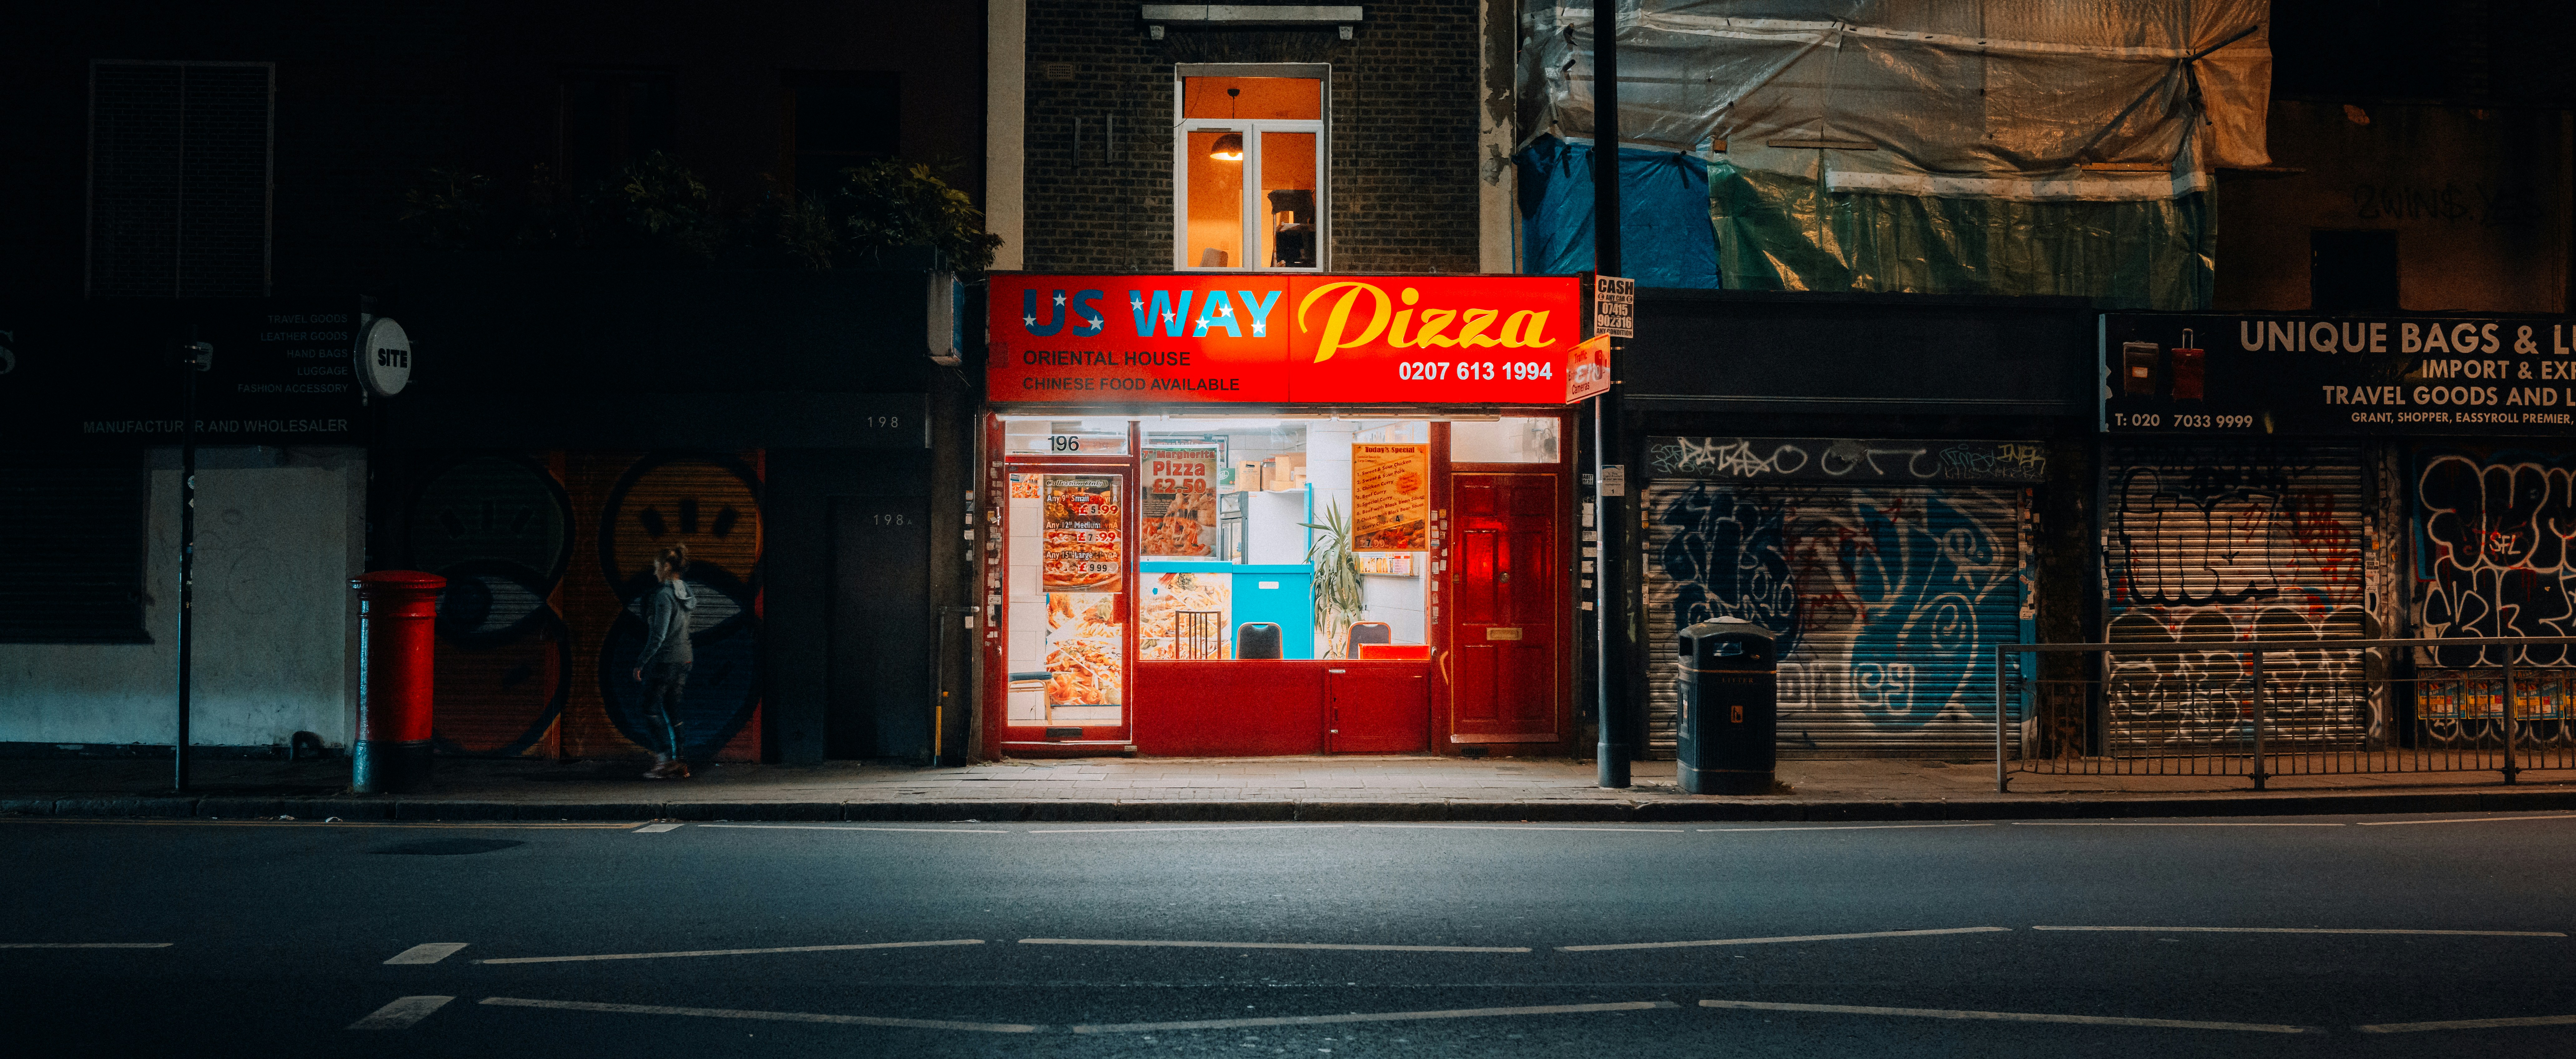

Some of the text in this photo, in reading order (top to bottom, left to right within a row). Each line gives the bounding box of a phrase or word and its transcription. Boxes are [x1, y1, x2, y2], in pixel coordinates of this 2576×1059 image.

[1598, 279, 1634, 295] CASH
[1023, 289, 1282, 337] US WAY
[1602, 302, 1628, 316] 07415
[268, 314, 348, 324] TRAVEL GOODS
[1298, 282, 1556, 363] Pizza
[1598, 314, 1632, 328] 902316
[261, 332, 348, 341] LEATHER GOODS
[2241, 321, 2576, 355] UNIQUE BAGS & L
[287, 349, 348, 358] HAND BAGS
[378, 348, 407, 368] SITE
[1023, 351, 1190, 366] ORIENTAL HOUSE
[1574, 350, 1587, 364] Traffic
[298, 367, 348, 376] LUGGAGE
[1399, 362, 1552, 380] 0207 613 1994
[2423, 359, 2509, 379] IMPORT
[2518, 361, 2533, 380] &
[238, 384, 348, 393] FASHION ACCESSORY
[1023, 377, 1239, 391] CHINESE FOOD AVAILABLE
[1572, 382, 1590, 395] Cameras
[2322, 386, 2405, 405] TRAVEL
[2413, 386, 2498, 406] GOODS
[2506, 387, 2558, 406] AND
[868, 416, 898, 428] 198
[2115, 413, 2253, 428] T: 020 7033 9999
[2351, 412, 2574, 425] GRANT, SHOPPER, EASSYROLL PREMIER,
[83, 419, 348, 434] MANUFACTURR AND WHOLESALER
[1048, 436, 1079, 451] 196
[1156, 450, 1215, 460] Margherita
[1153, 460, 1205, 476] Pizza
[1153, 479, 1206, 494] £2.50
[1047, 494, 1060, 504] Any
[1362, 498, 1378, 506] Special
[1046, 521, 1059, 530] Any
[2489, 532, 2521, 554] SFL
[1046, 551, 1060, 560] Any
[1074, 551, 1093, 560] Large
